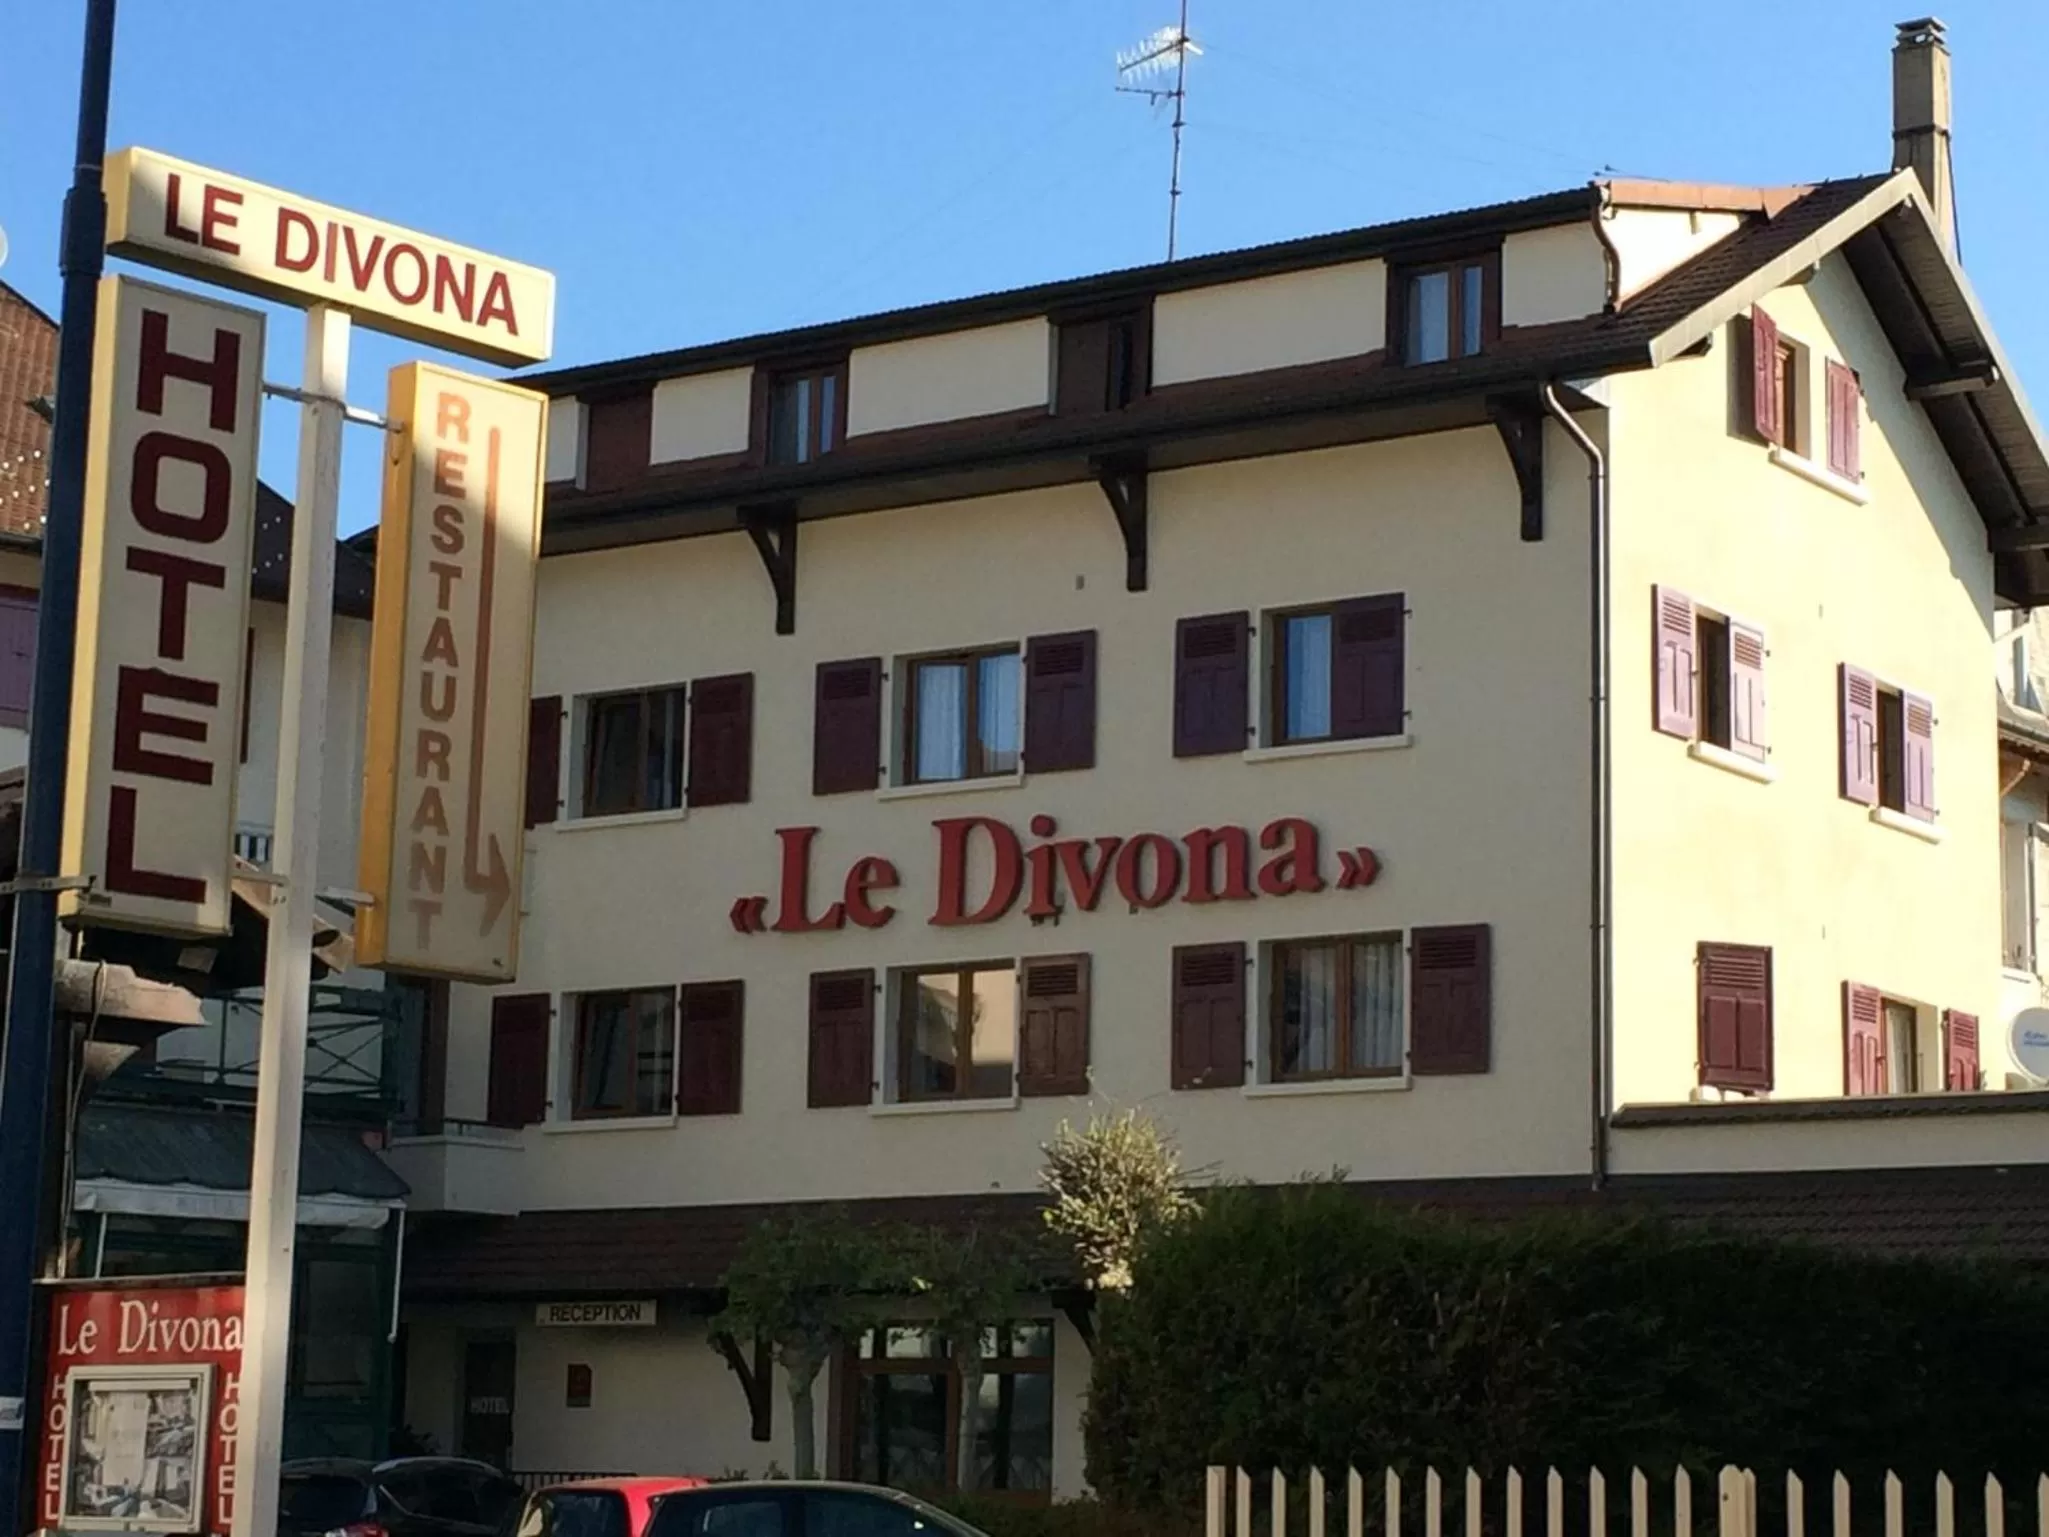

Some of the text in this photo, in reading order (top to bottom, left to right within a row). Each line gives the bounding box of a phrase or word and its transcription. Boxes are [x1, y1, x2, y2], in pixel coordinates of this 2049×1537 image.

[164, 172, 520, 336] LE DIVONA
[105, 308, 241, 904] HOTEL
[406, 391, 472, 950] RESTAURANT
[57, 1300, 244, 1355] Le Divona
[549, 1303, 641, 1322] RECEPTION
[470, 1396, 510, 1414] HOTEL
